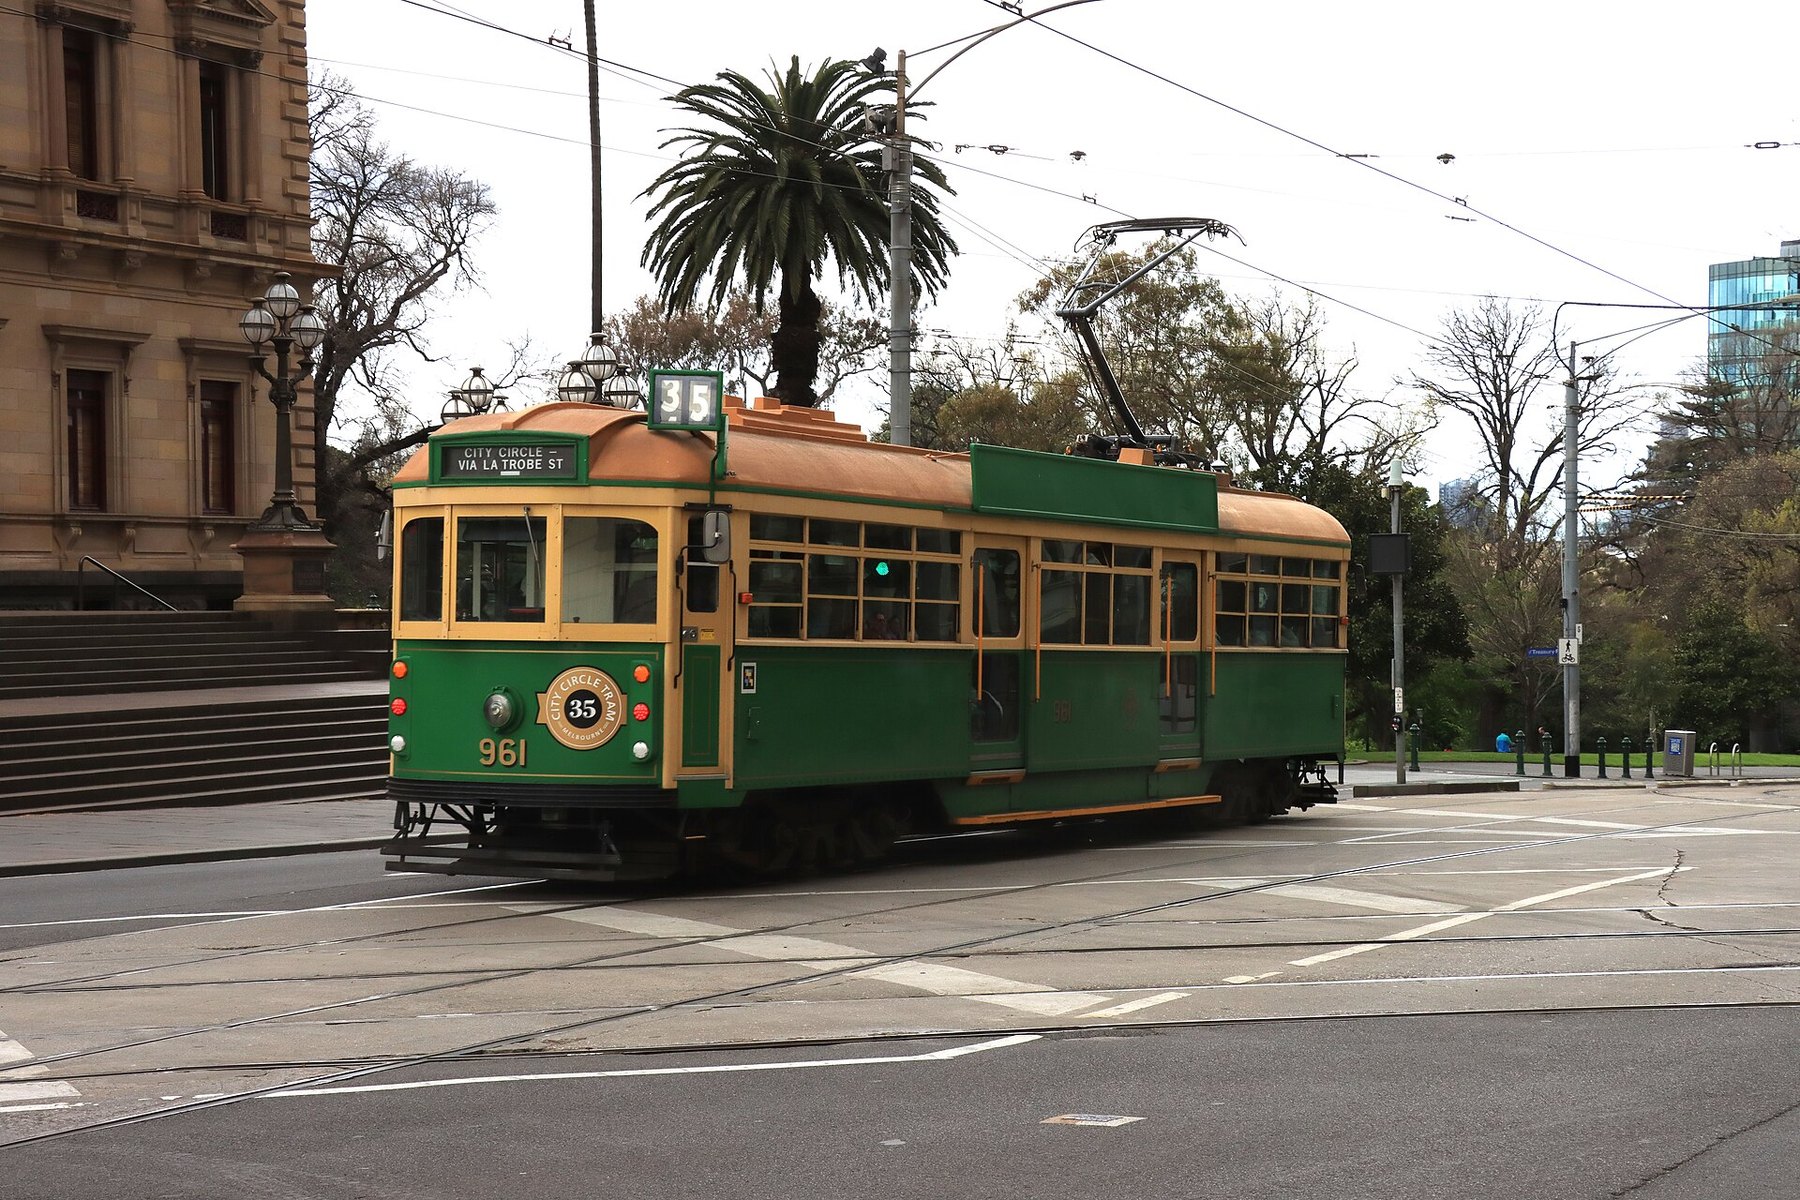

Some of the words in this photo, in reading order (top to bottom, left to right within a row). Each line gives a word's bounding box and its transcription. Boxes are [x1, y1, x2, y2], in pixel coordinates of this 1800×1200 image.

[660, 379, 709, 422] 35
[464, 447, 493, 458] CITY
[498, 446, 543, 458] CIRCLE
[458, 459, 478, 471] VIA
[483, 459, 499, 470] LA
[501, 459, 542, 470] TROBE
[548, 458, 564, 470] ST
[550, 691, 562, 721] CITY
[560, 674, 602, 692] CIRCLE
[600, 684, 617, 722] TRAM
[568, 698, 597, 719] 35
[561, 727, 605, 741] MELBOURNE
[479, 737, 527, 767] 961
